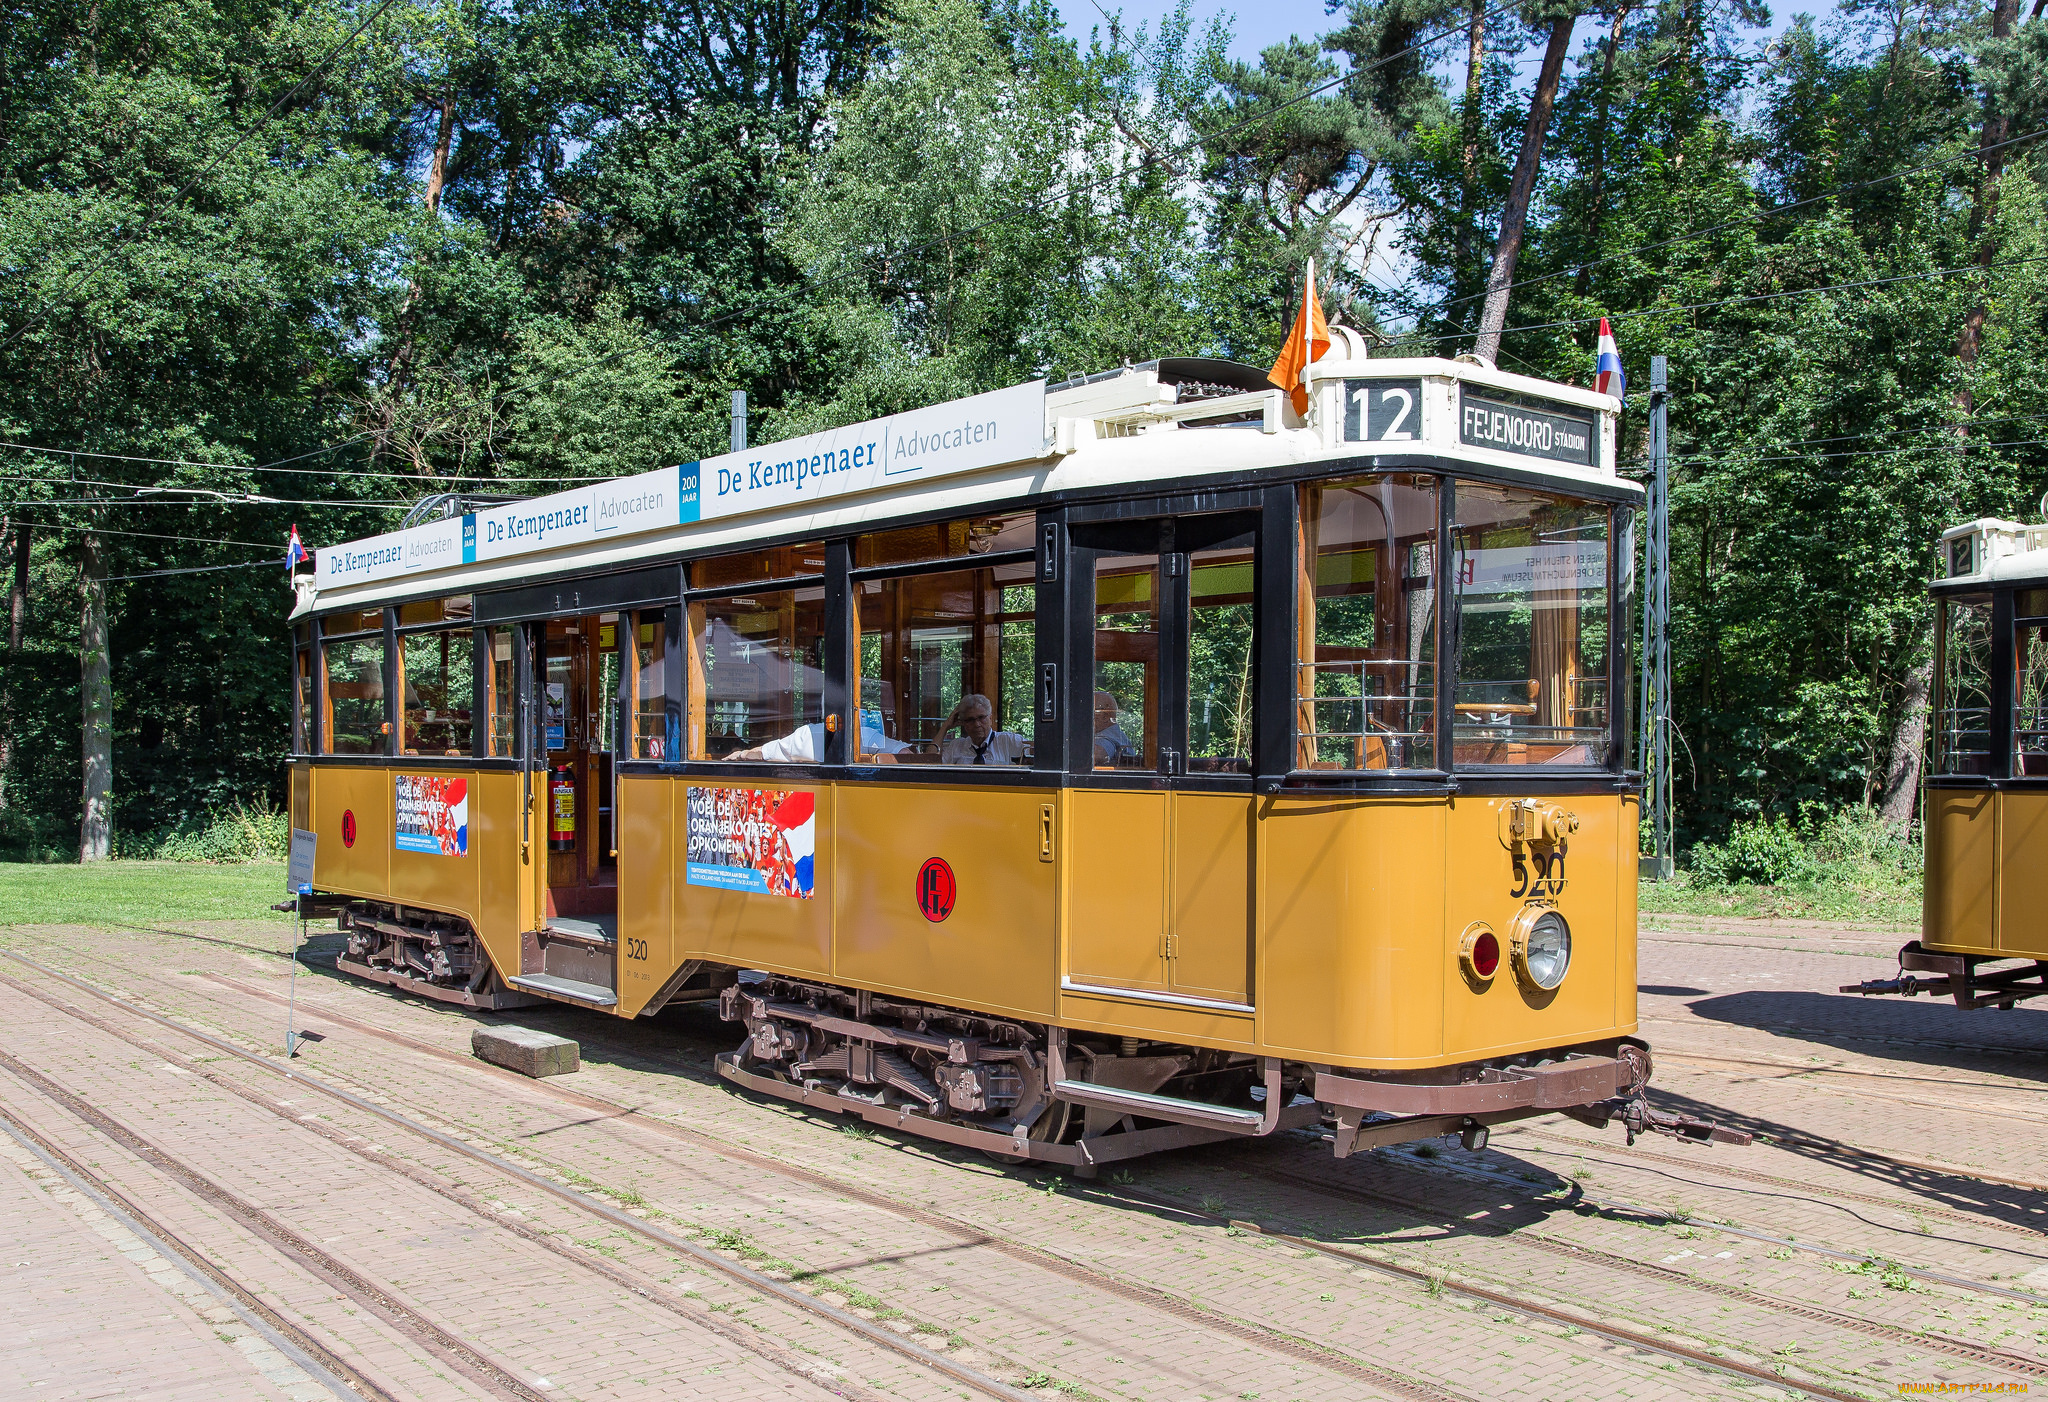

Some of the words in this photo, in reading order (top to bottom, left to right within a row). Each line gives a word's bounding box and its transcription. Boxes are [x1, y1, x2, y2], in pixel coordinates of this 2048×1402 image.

[1352, 388, 1413, 441] 12
[894, 420, 997, 460] Advocaten
[1554, 431, 1586, 452] STADION
[718, 468, 741, 496] De
[748, 442, 876, 490] Kempenaer
[682, 475, 697, 491] 200
[600, 491, 664, 520] Advocaten
[682, 492, 697, 504] JAAR
[464, 524, 475, 538] 200
[487, 520, 504, 543] De
[507, 504, 589, 540] Kempenaer
[409, 537, 453, 558] Advocaten
[464, 538, 475, 548] JAAR
[331, 556, 342, 574] De
[345, 545, 402, 573] Kempenaer
[690, 800, 716, 816] VOEL
[718, 801, 731, 816] DE
[690, 818, 772, 838] ORANJEKOORTS
[690, 836, 740, 854] OPKOMEN
[1510, 852, 1565, 898] 520
[627, 937, 648, 961] 520
